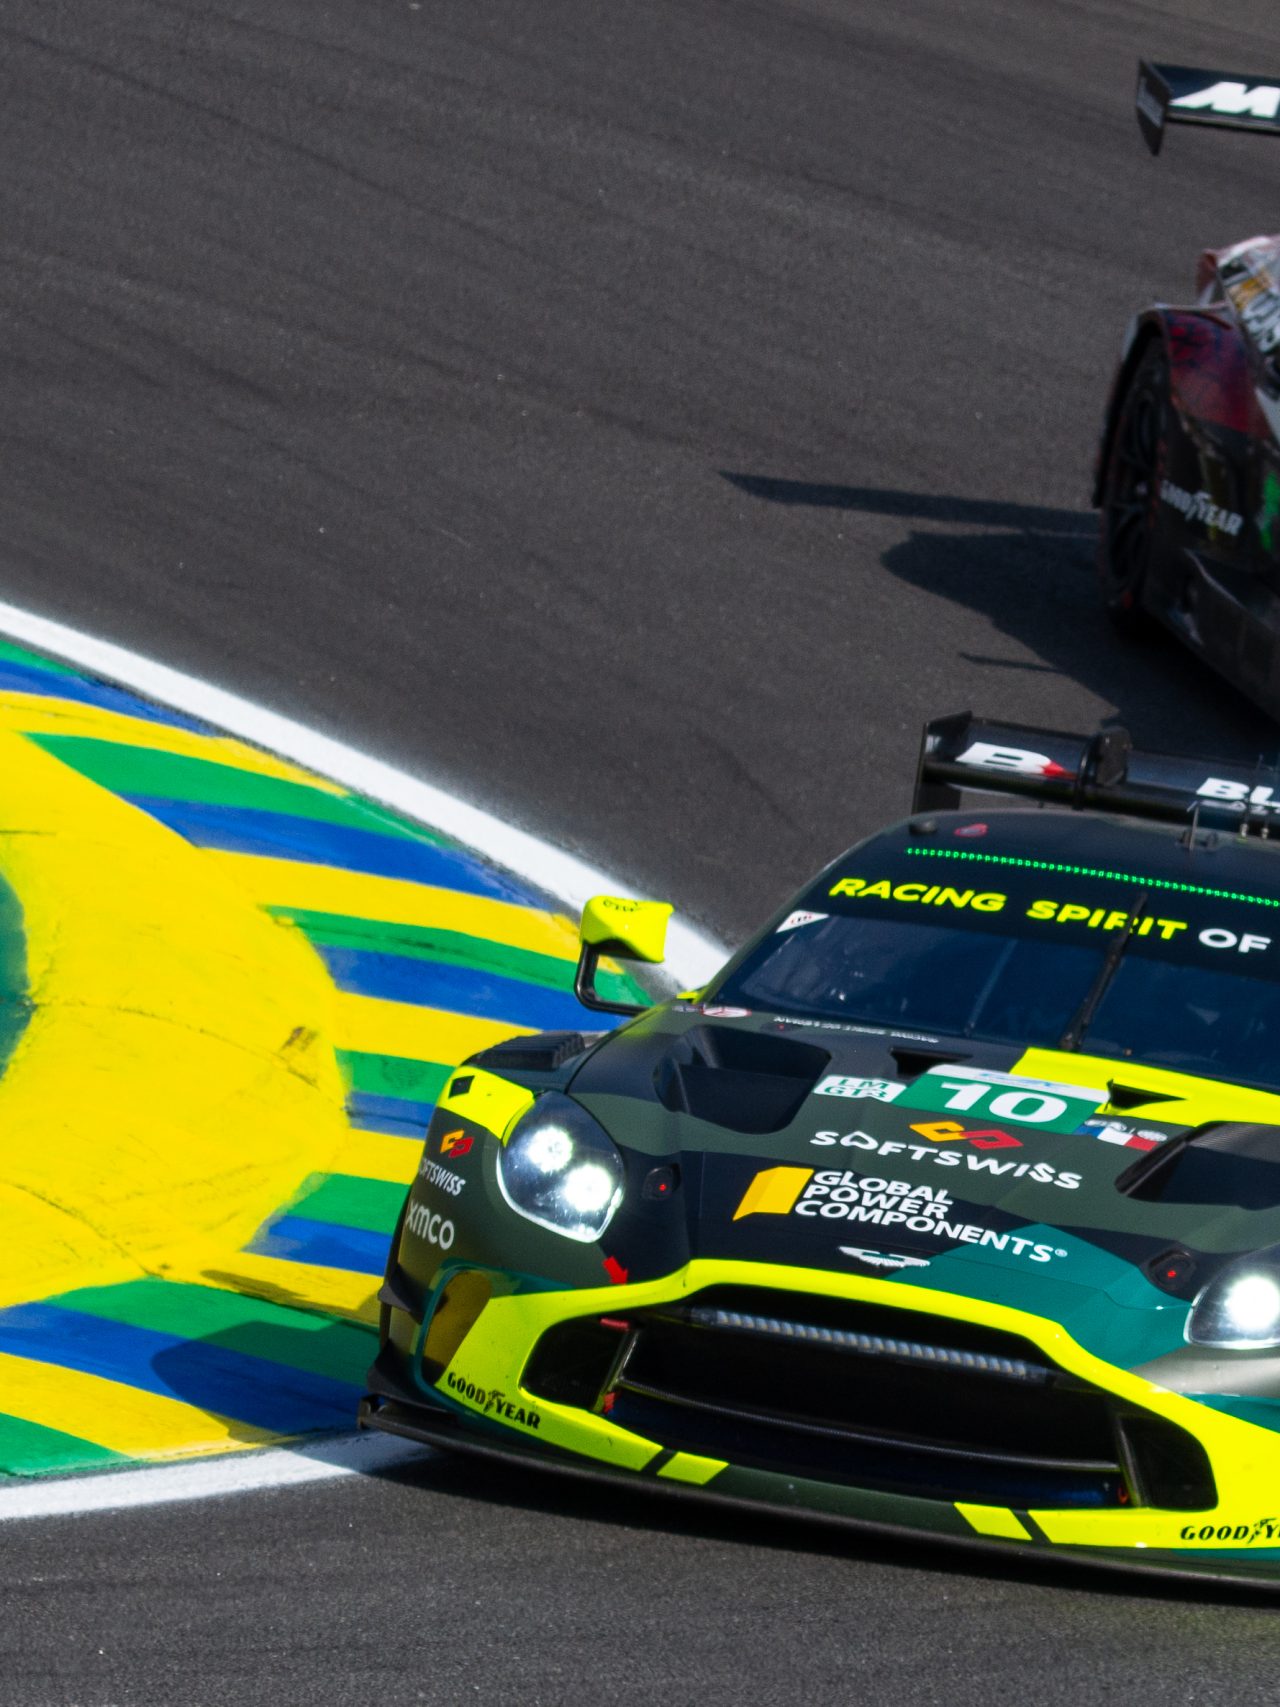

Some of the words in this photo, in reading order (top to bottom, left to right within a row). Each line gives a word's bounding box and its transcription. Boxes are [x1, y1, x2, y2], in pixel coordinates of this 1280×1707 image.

[828, 877, 1007, 912] RACING
[1026, 900, 1188, 941] SPIRIT
[1199, 928, 1271, 953] OF
[837, 1078, 889, 1090] LM
[940, 1081, 1068, 1124] 10
[809, 1129, 1083, 1191] SOFTSWISS
[802, 1184, 949, 1220] POWER
[813, 1170, 954, 1206] GLOBAL
[447, 1370, 541, 1431] GOODYEAR
